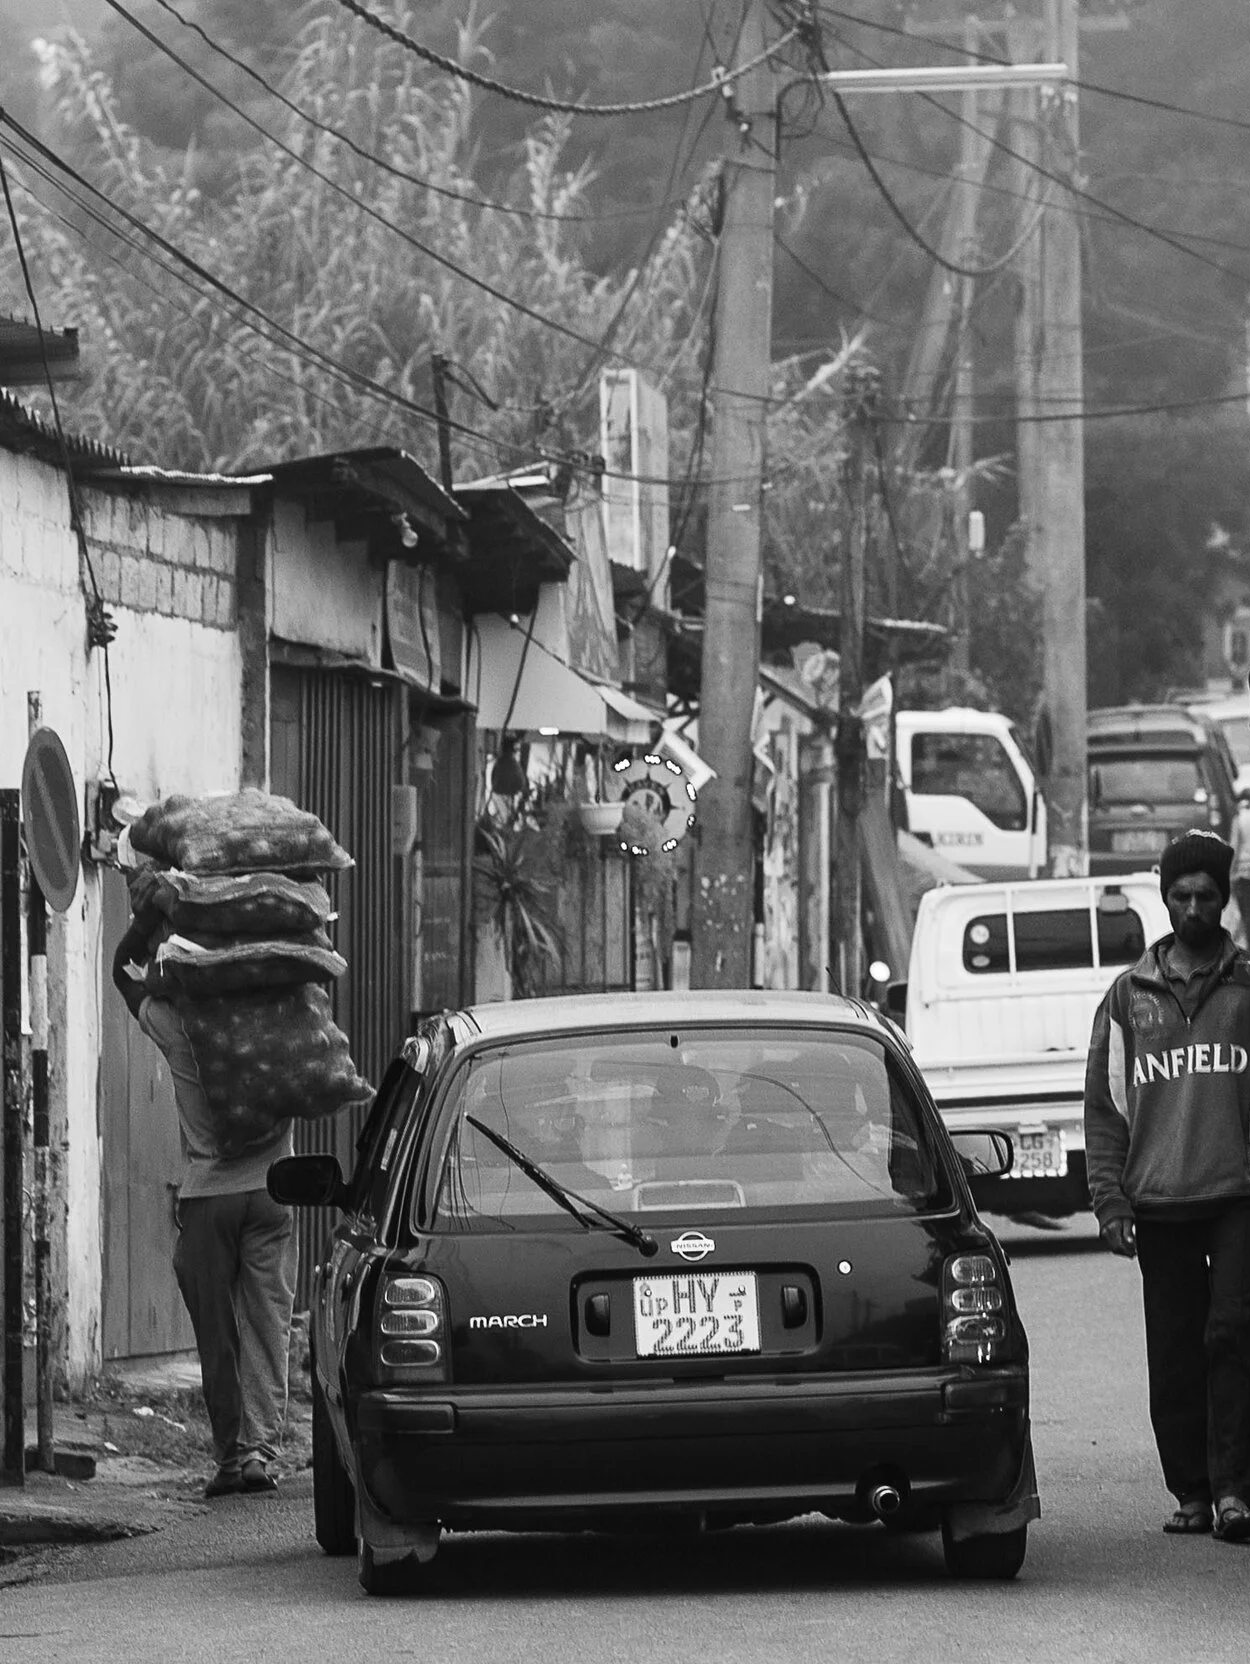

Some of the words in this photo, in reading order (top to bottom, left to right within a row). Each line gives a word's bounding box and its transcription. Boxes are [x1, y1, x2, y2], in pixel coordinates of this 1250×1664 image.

[1132, 1042, 1248, 1087] ANFIELD
[672, 1278, 719, 1314] HY
[469, 1314, 547, 1328] MARCH
[652, 1315, 744, 1353] 2223
